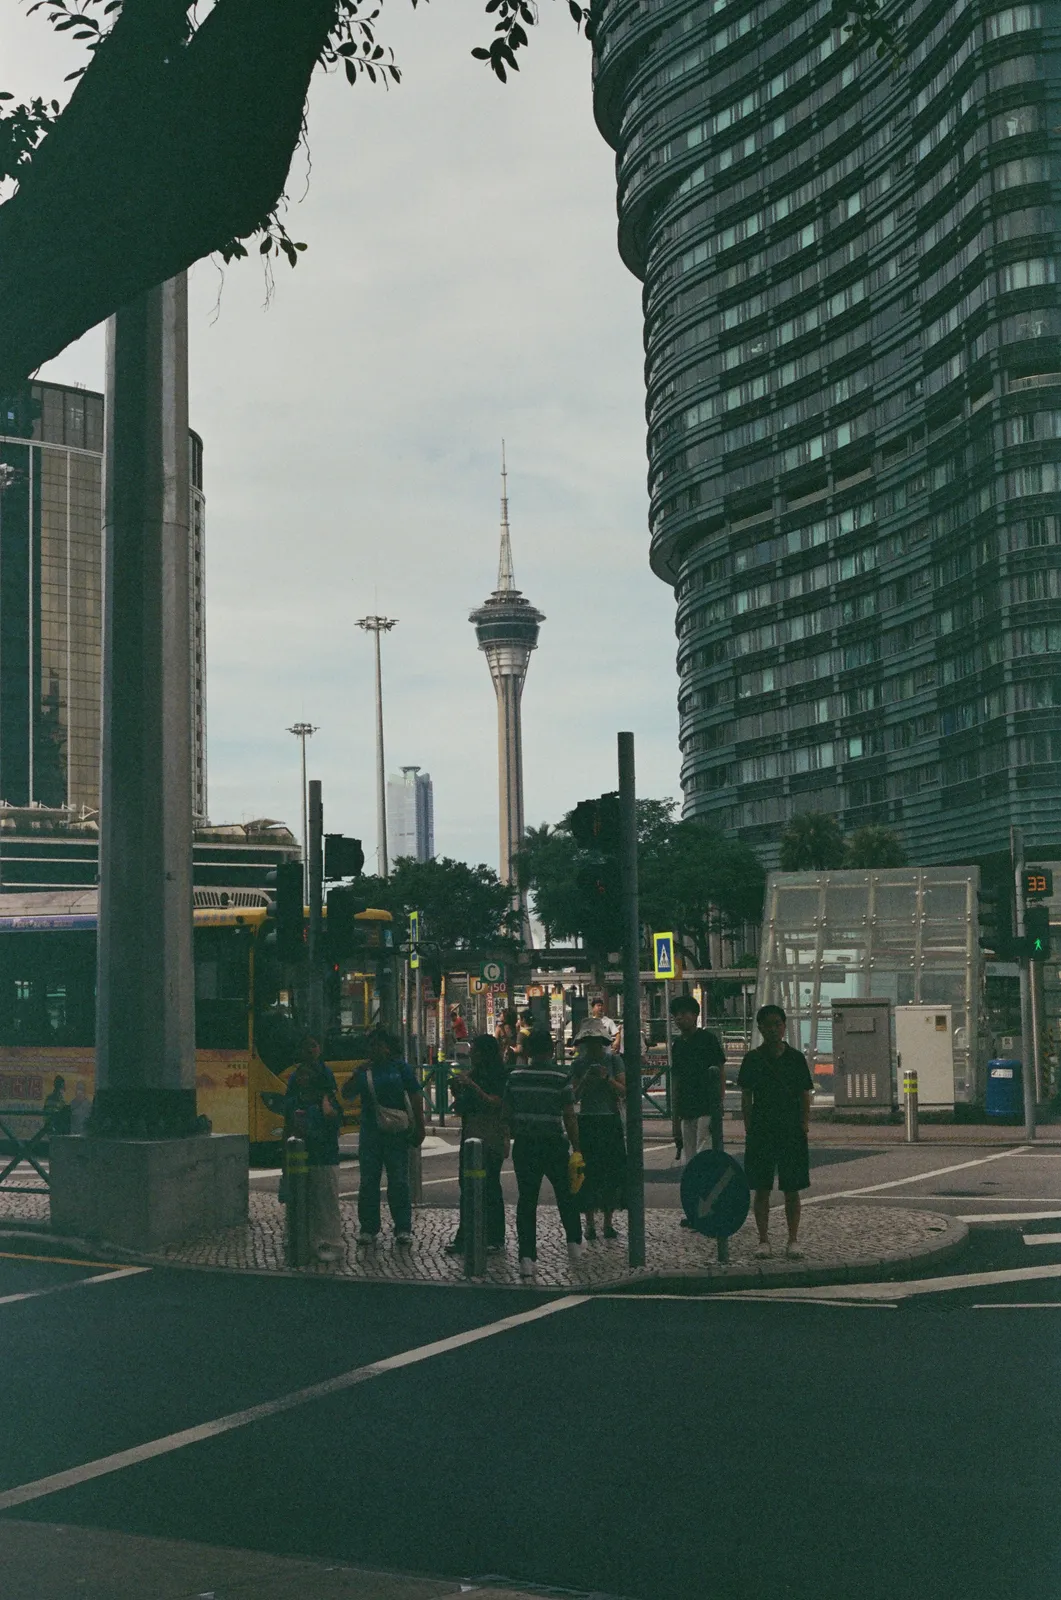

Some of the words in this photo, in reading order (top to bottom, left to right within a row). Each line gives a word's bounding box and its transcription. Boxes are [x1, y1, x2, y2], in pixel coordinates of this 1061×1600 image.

[1027, 876, 1047, 892] 33
[487, 965, 496, 979] C
[475, 980, 483, 991] D
